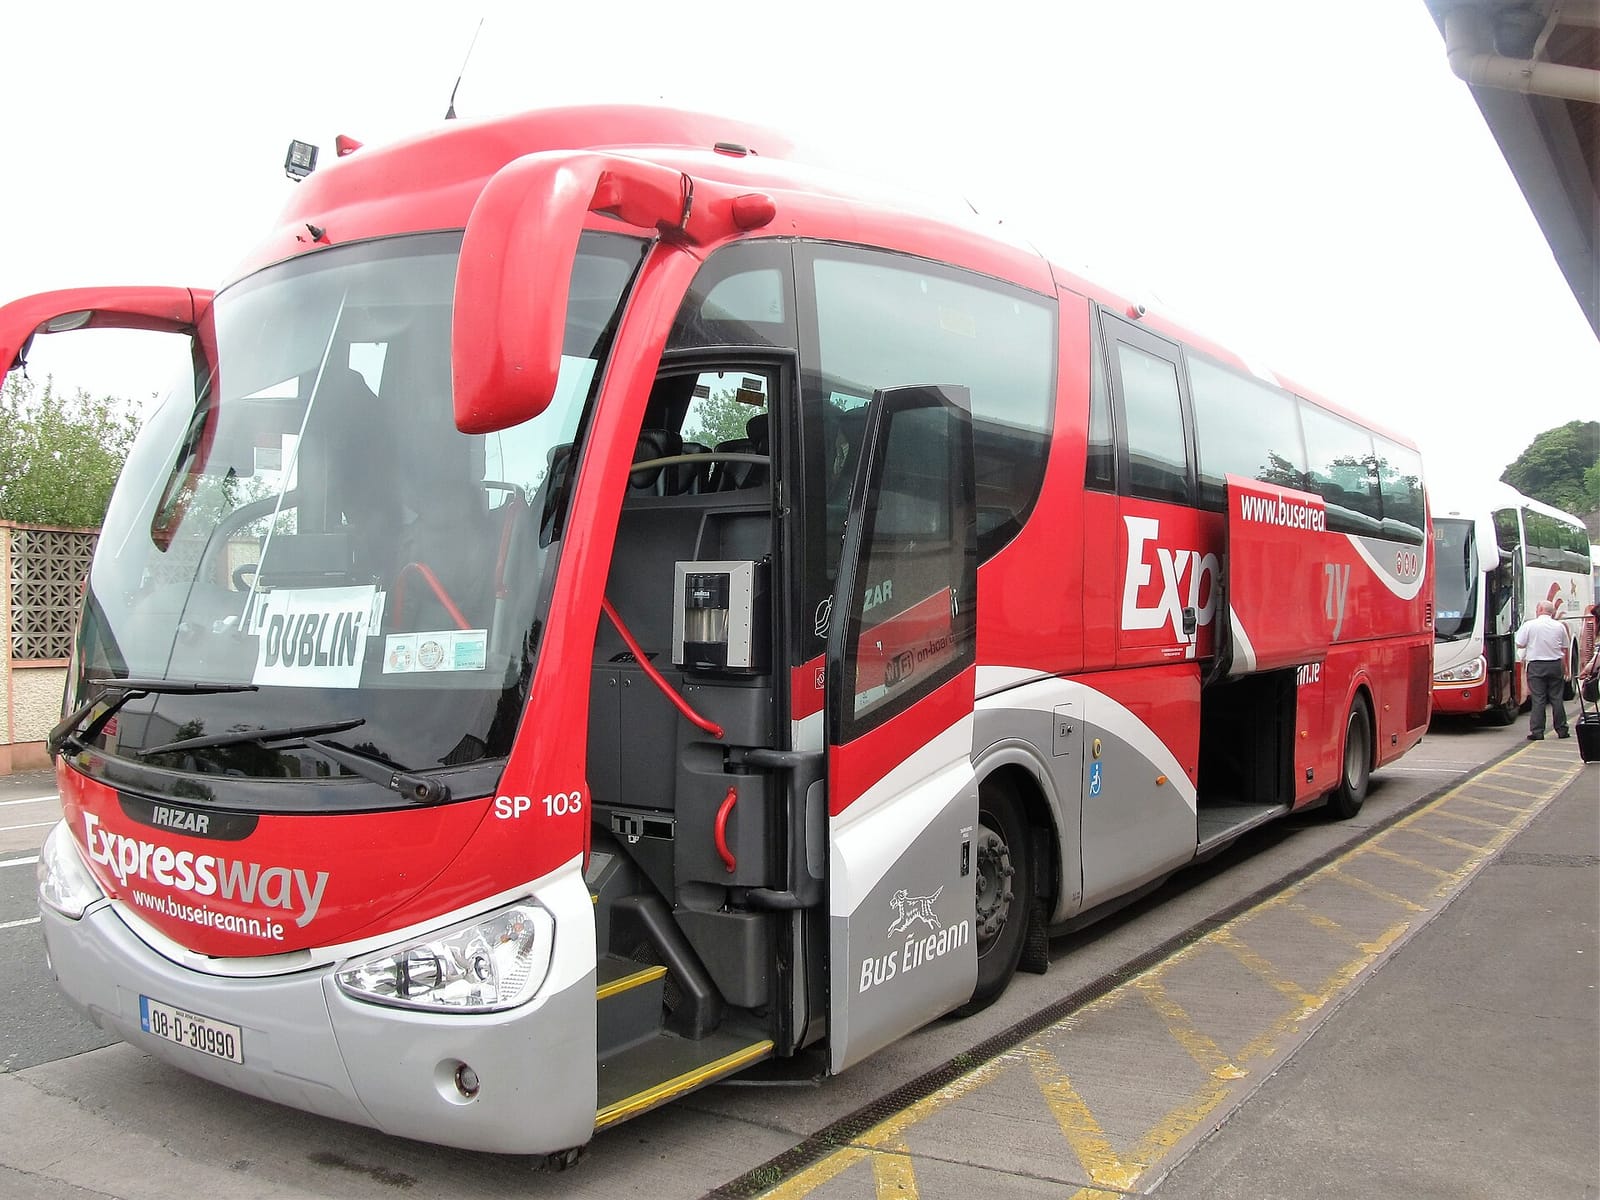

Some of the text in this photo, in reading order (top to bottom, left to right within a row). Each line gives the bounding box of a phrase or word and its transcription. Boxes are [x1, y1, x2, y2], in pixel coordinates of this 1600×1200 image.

[264, 611, 363, 668] DUBLIN
[152, 806, 209, 834] IRIZAR
[494, 791, 582, 819] SP 103
[83, 810, 329, 928] Expressway
[132, 888, 284, 940] www.buseireann.ie
[859, 919, 969, 993] Bus Éireann
[152, 1009, 235, 1059] 08-D-30990
